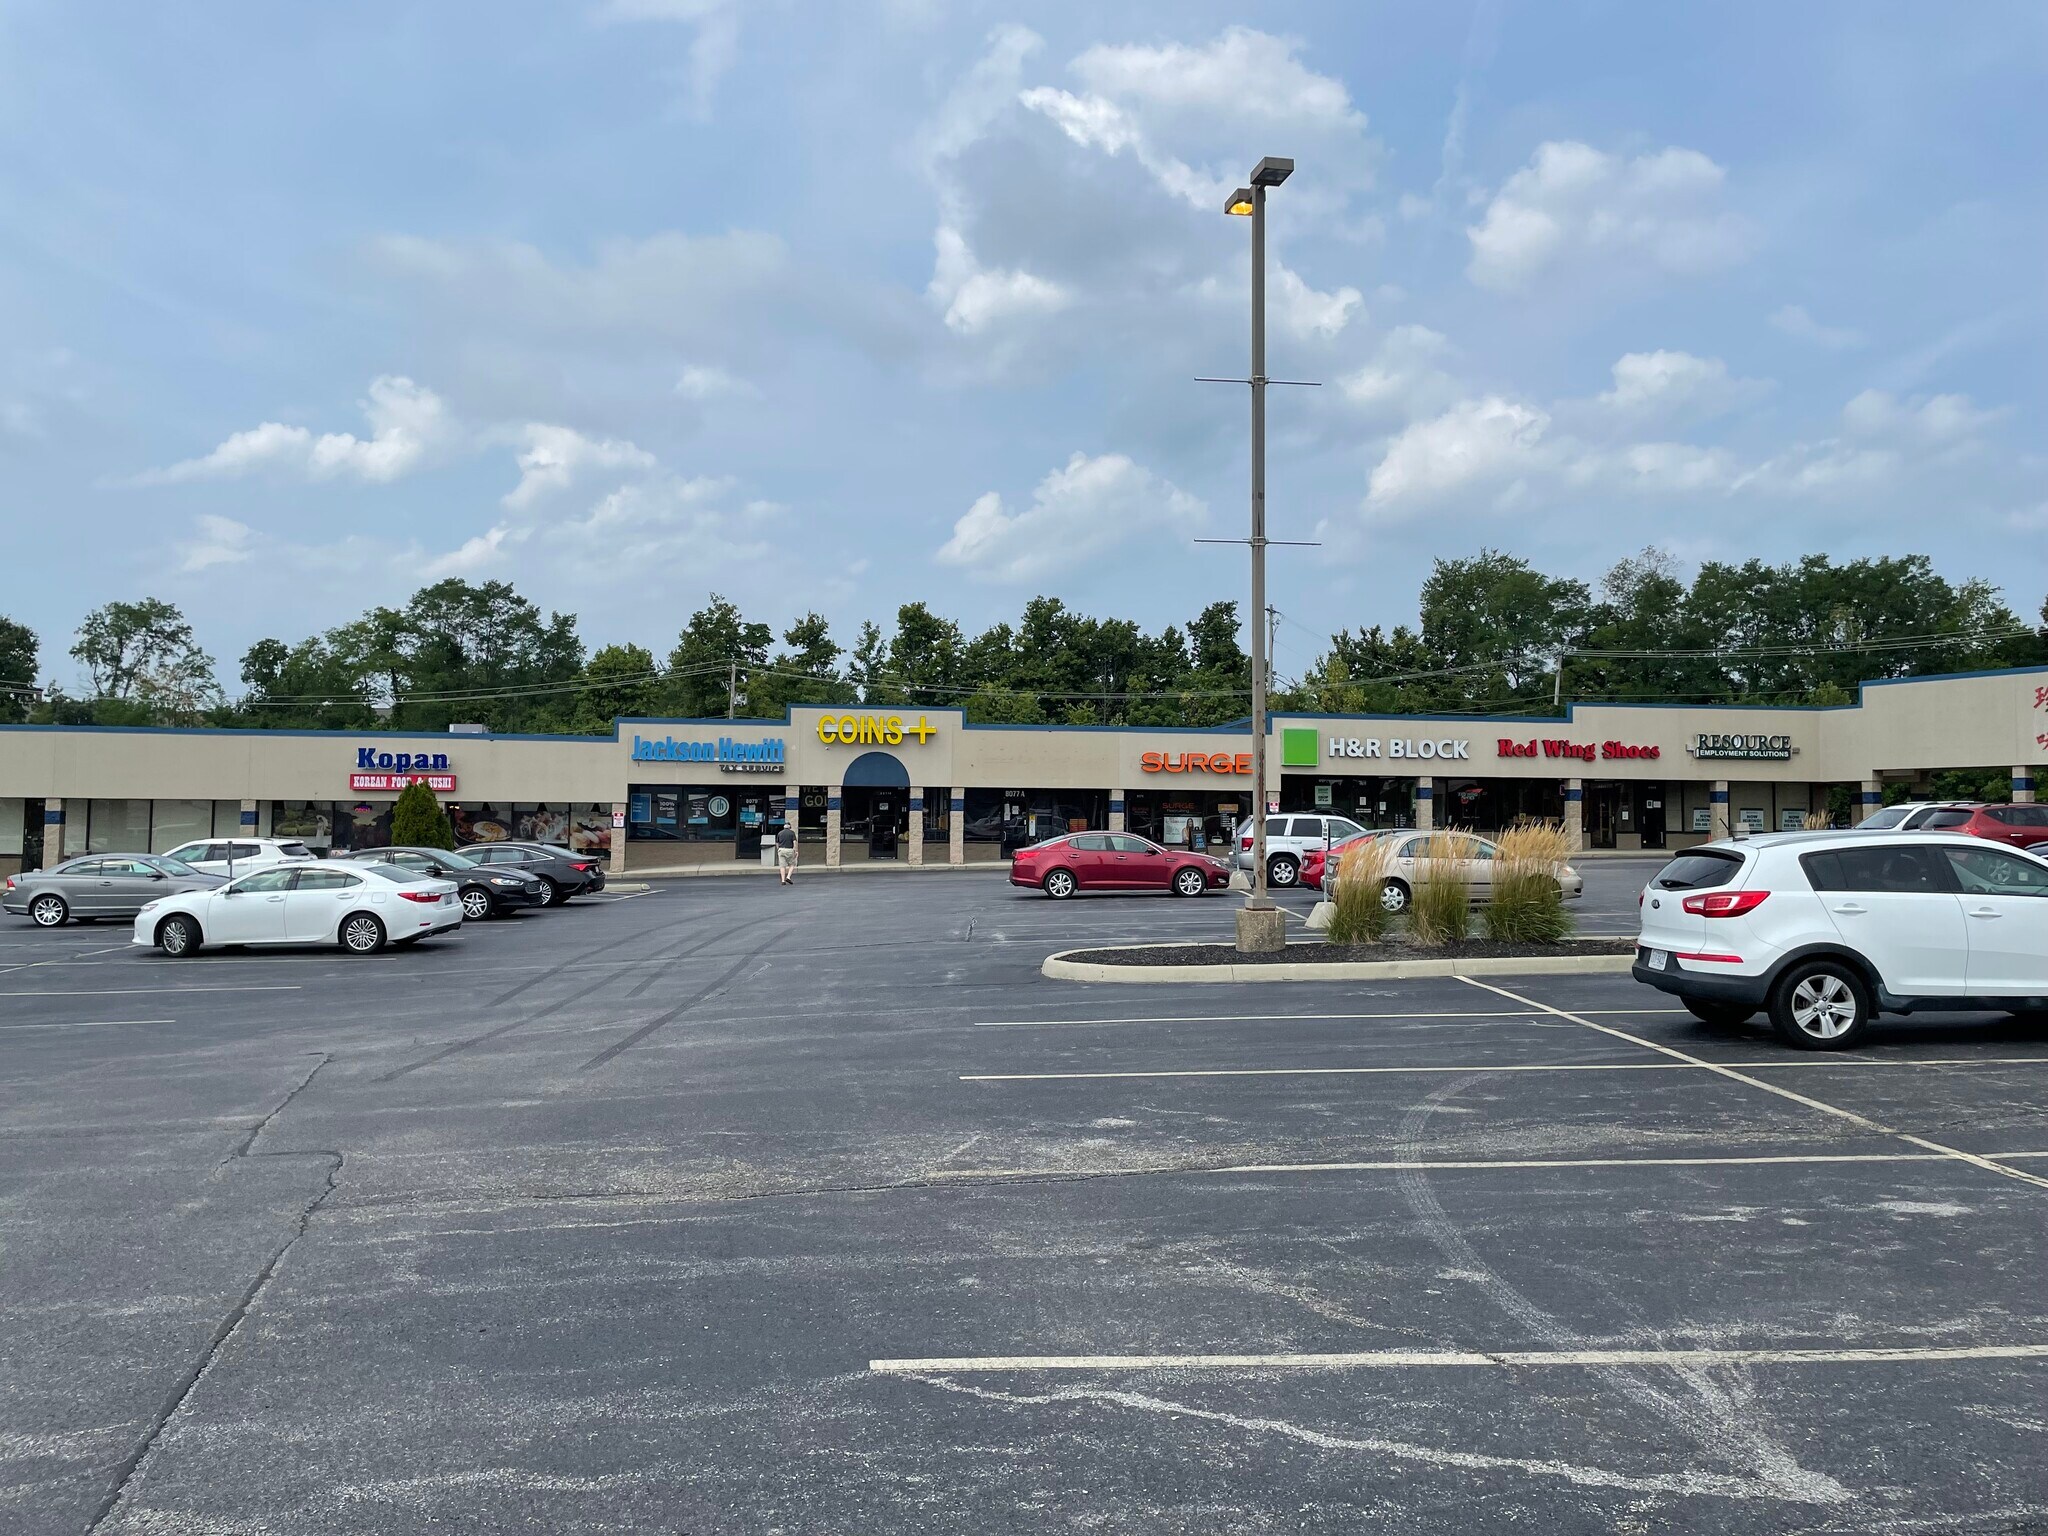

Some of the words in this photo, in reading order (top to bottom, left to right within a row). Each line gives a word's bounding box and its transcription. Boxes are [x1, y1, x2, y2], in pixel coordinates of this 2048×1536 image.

[818, 715, 903, 745] COINS
[631, 735, 714, 761] Jackson
[718, 738, 785, 762] Hewitt
[1328, 737, 1381, 759] H&R
[1389, 738, 1470, 760] BLOCK
[1497, 739, 1539, 758] Red
[1541, 739, 1597, 762] Wing
[1602, 740, 1661, 760] Shoes
[1696, 733, 1792, 750] RESOURCE
[357, 747, 450, 774] Kopan
[1141, 752, 1253, 774] SURGE
[1699, 749, 1747, 757] EMPLOYMENT
[1749, 750, 1789, 758] SOLUTIONS
[719, 765, 739, 773] TAX
[742, 765, 785, 774] SERVICE
[353, 776, 388, 788] KOREAN
[428, 777, 452, 789] SUSHI
